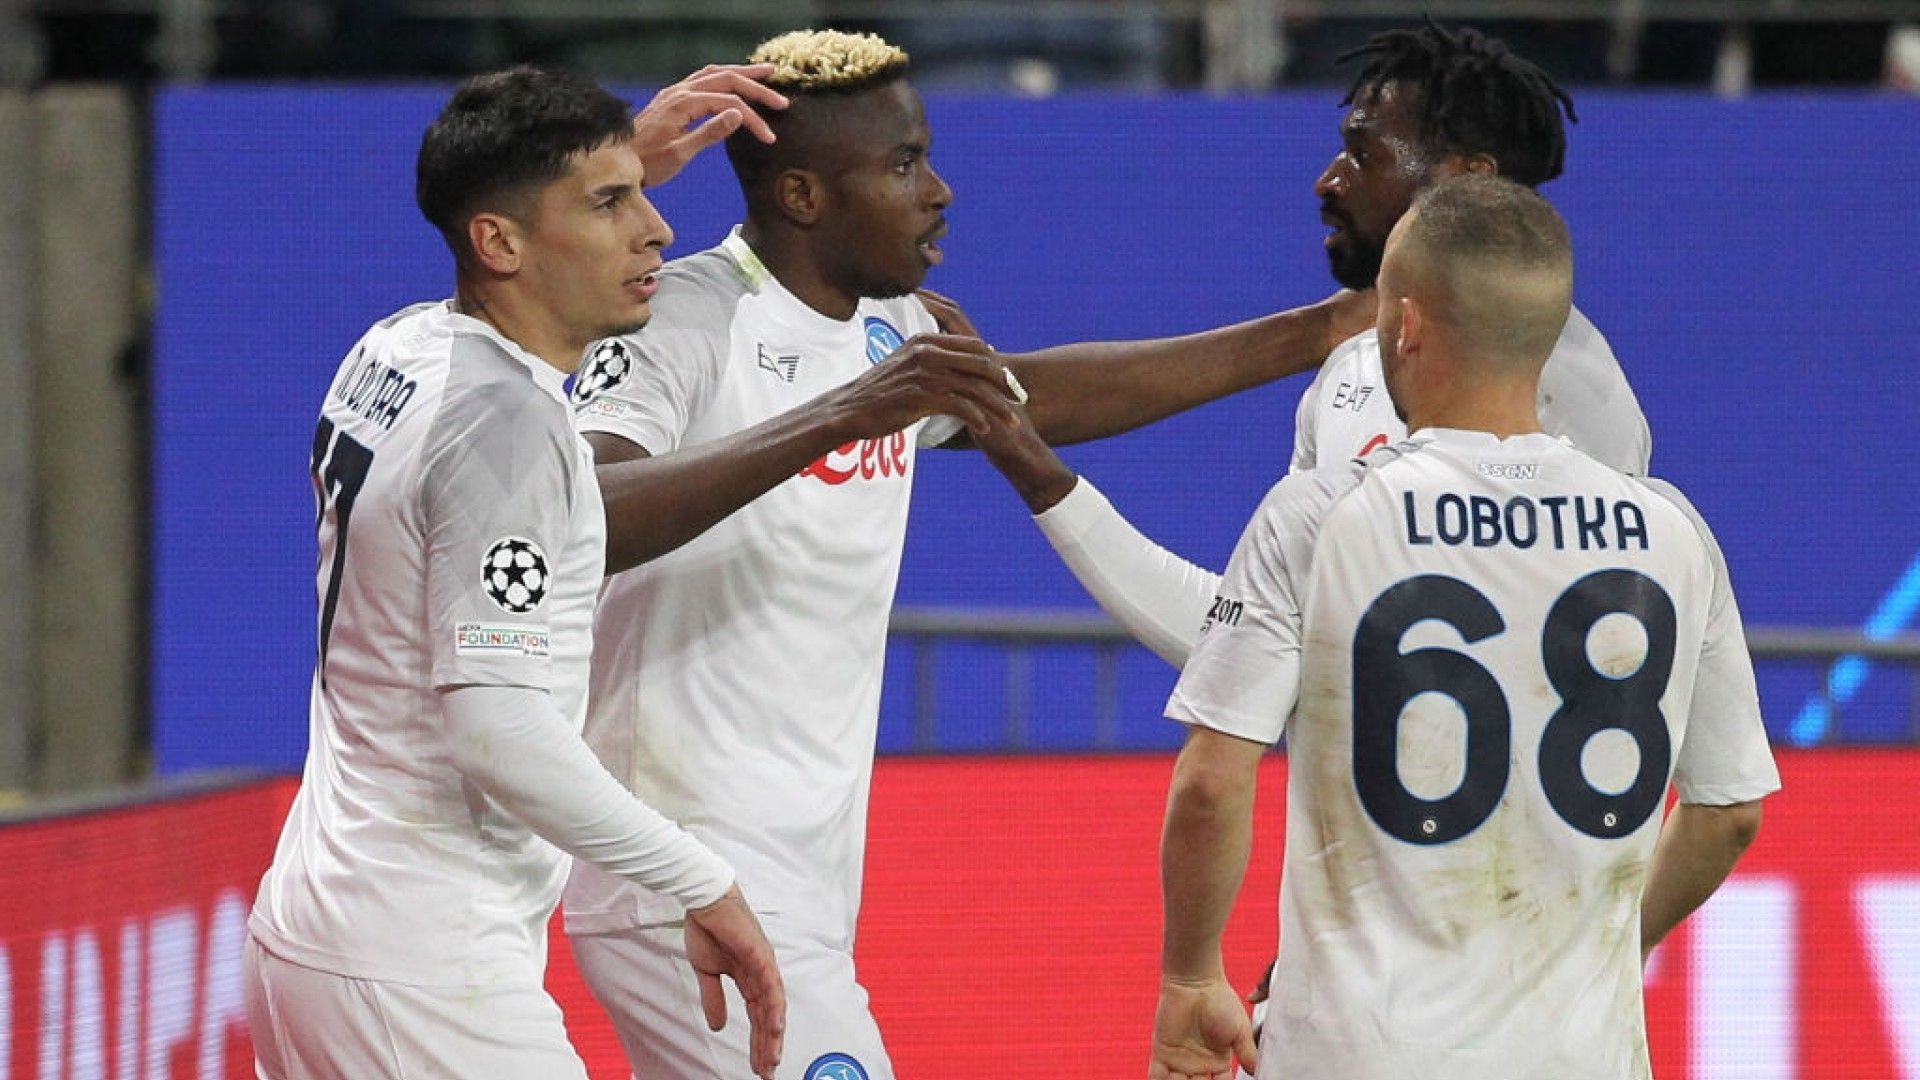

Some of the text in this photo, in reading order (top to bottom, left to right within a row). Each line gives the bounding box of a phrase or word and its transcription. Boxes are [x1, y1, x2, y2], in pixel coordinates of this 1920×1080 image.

[1333, 382, 1375, 412] EA7
[1402, 490, 1650, 551] LOBOTKA
[458, 630, 549, 649] FOUNDATION
[1352, 567, 1678, 847] 68
